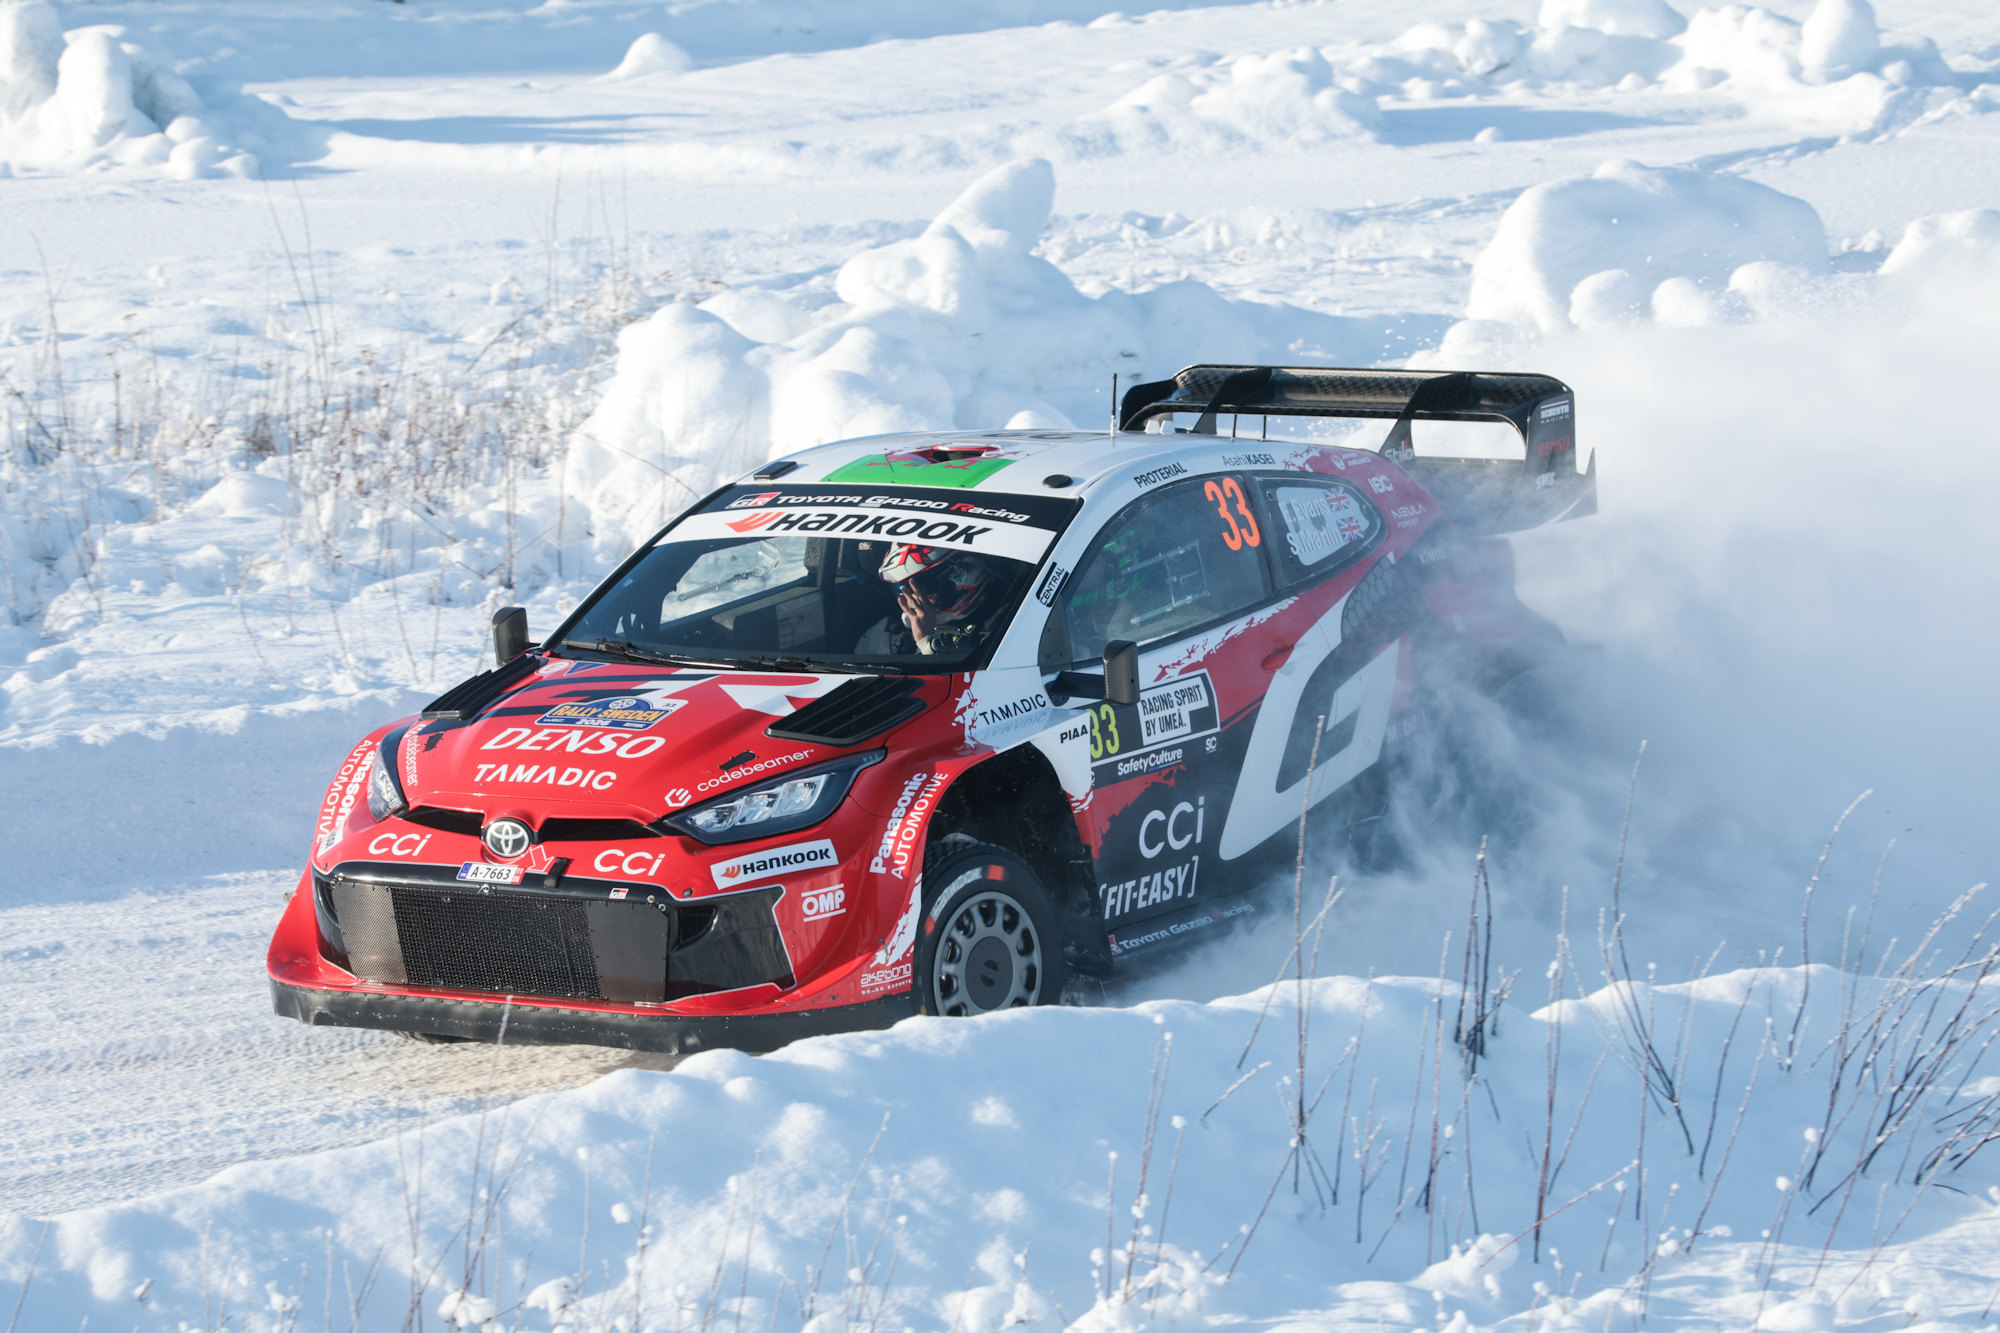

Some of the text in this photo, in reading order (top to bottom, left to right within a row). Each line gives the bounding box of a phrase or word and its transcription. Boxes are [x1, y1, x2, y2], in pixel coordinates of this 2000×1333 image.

[1541, 414, 1570, 424] RACING
[1385, 440, 1414, 462] Stilo
[1538, 436, 1570, 456] DENSO
[1222, 453, 1276, 467] AsahiKASEI
[1133, 462, 1188, 488] PROTERIAL
[776, 495, 863, 504] TOYOTA
[868, 496, 948, 510] GAZOO
[950, 502, 1031, 523] Racing
[1204, 477, 1261, 551] 33
[1040, 568, 1065, 606] CENTRAL
[979, 694, 1046, 725] TAMADIC
[1141, 684, 1203, 716] RACING SPIRIT
[552, 705, 667, 722] RALLY SWEDEN
[575, 717, 613, 727] 2026
[1060, 725, 1088, 743] PIAA
[1086, 704, 1120, 759] 33
[1145, 718, 1156, 737] BY
[481, 727, 667, 759] DENSO
[1205, 736, 1217, 751] SC
[697, 750, 810, 792] codebeamer
[1118, 748, 1183, 776] SafetyCulture
[473, 764, 617, 790] TAMADIC
[870, 772, 928, 875] Panasonic
[891, 772, 948, 880] AUTOMOTIVE
[1139, 796, 1205, 859] CCi
[368, 833, 432, 856] CCi
[471, 866, 511, 880] A-7663
[594, 849, 665, 877] CCi
[802, 889, 845, 915] OMP
[1119, 930, 1169, 949] TOYOTA
[1170, 916, 1214, 935] GAZOO
[861, 964, 911, 984] akebono
